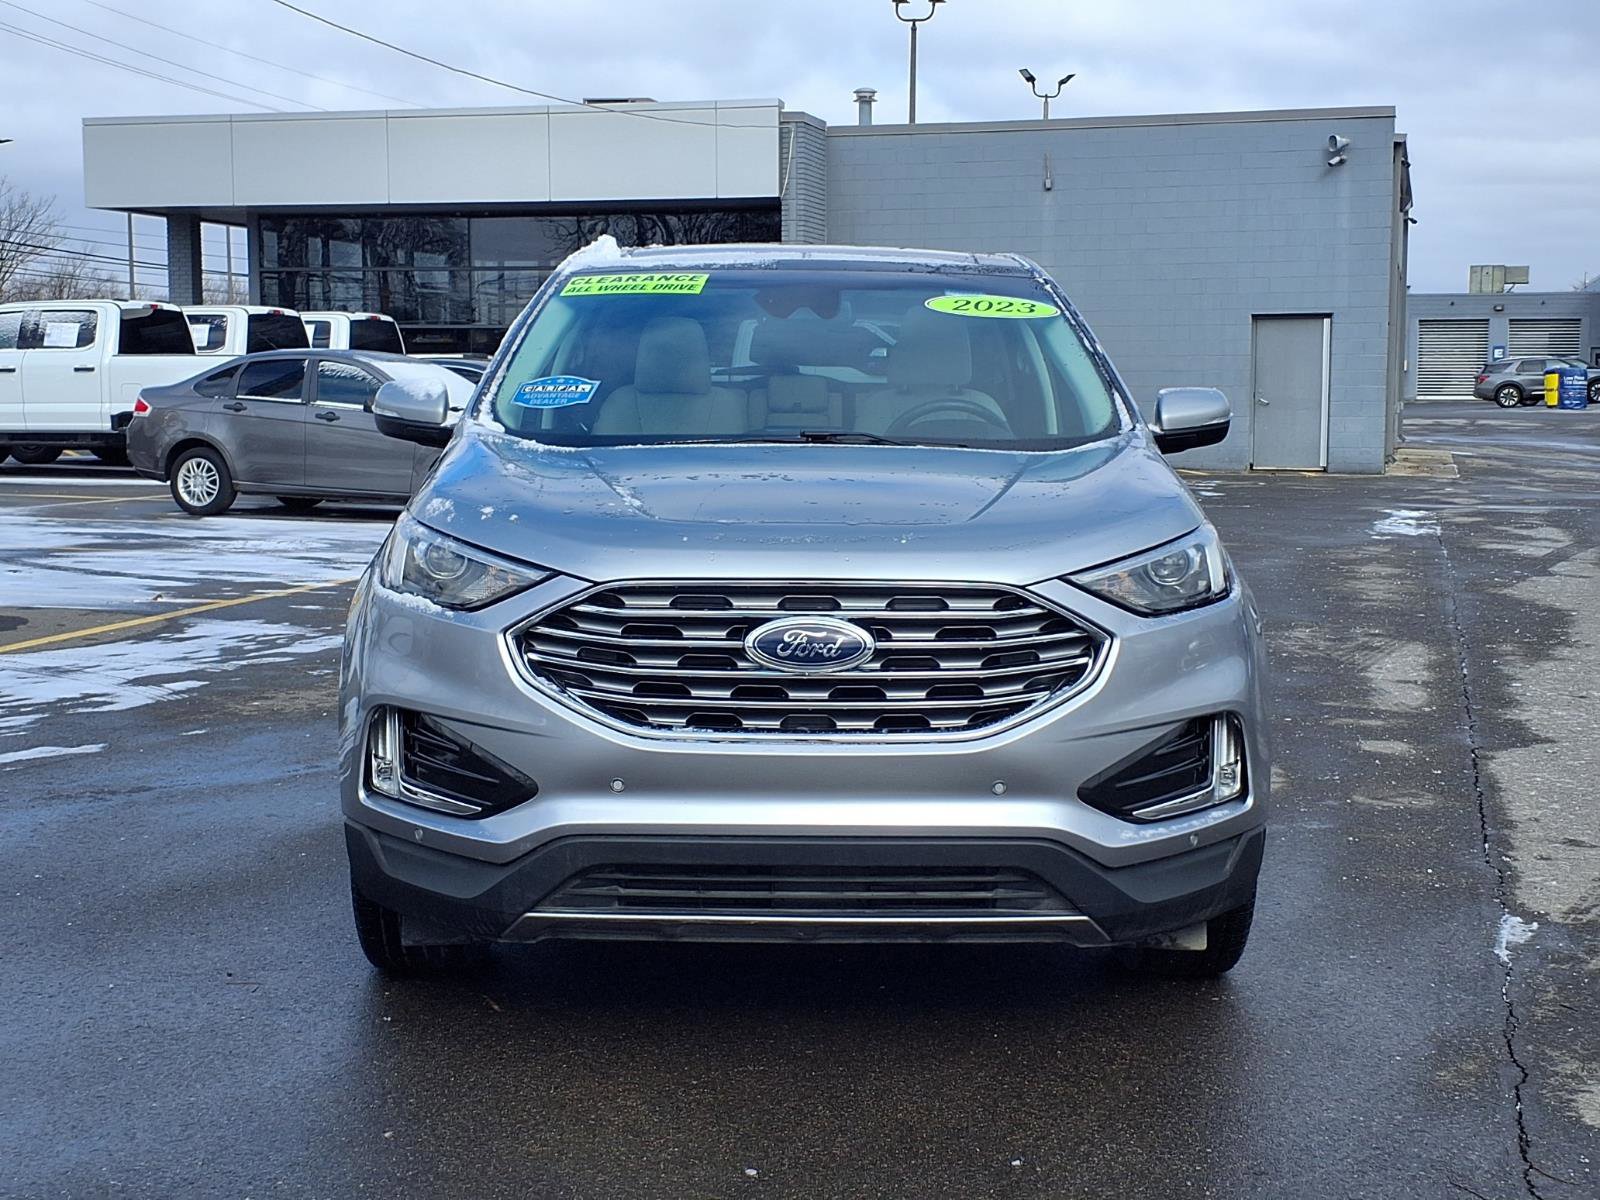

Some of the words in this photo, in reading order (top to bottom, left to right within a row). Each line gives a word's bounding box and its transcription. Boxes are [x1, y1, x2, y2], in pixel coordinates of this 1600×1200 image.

[570, 275, 701, 286] CLEARANCE
[565, 286, 593, 294] ALL
[599, 284, 649, 292] WHEEL
[651, 283, 698, 291] DRIVE
[952, 299, 1037, 314] 2023
[521, 384, 592, 393] CARFAX
[523, 392, 580, 400] ADVANTAGE
[776, 629, 844, 658] Ford
